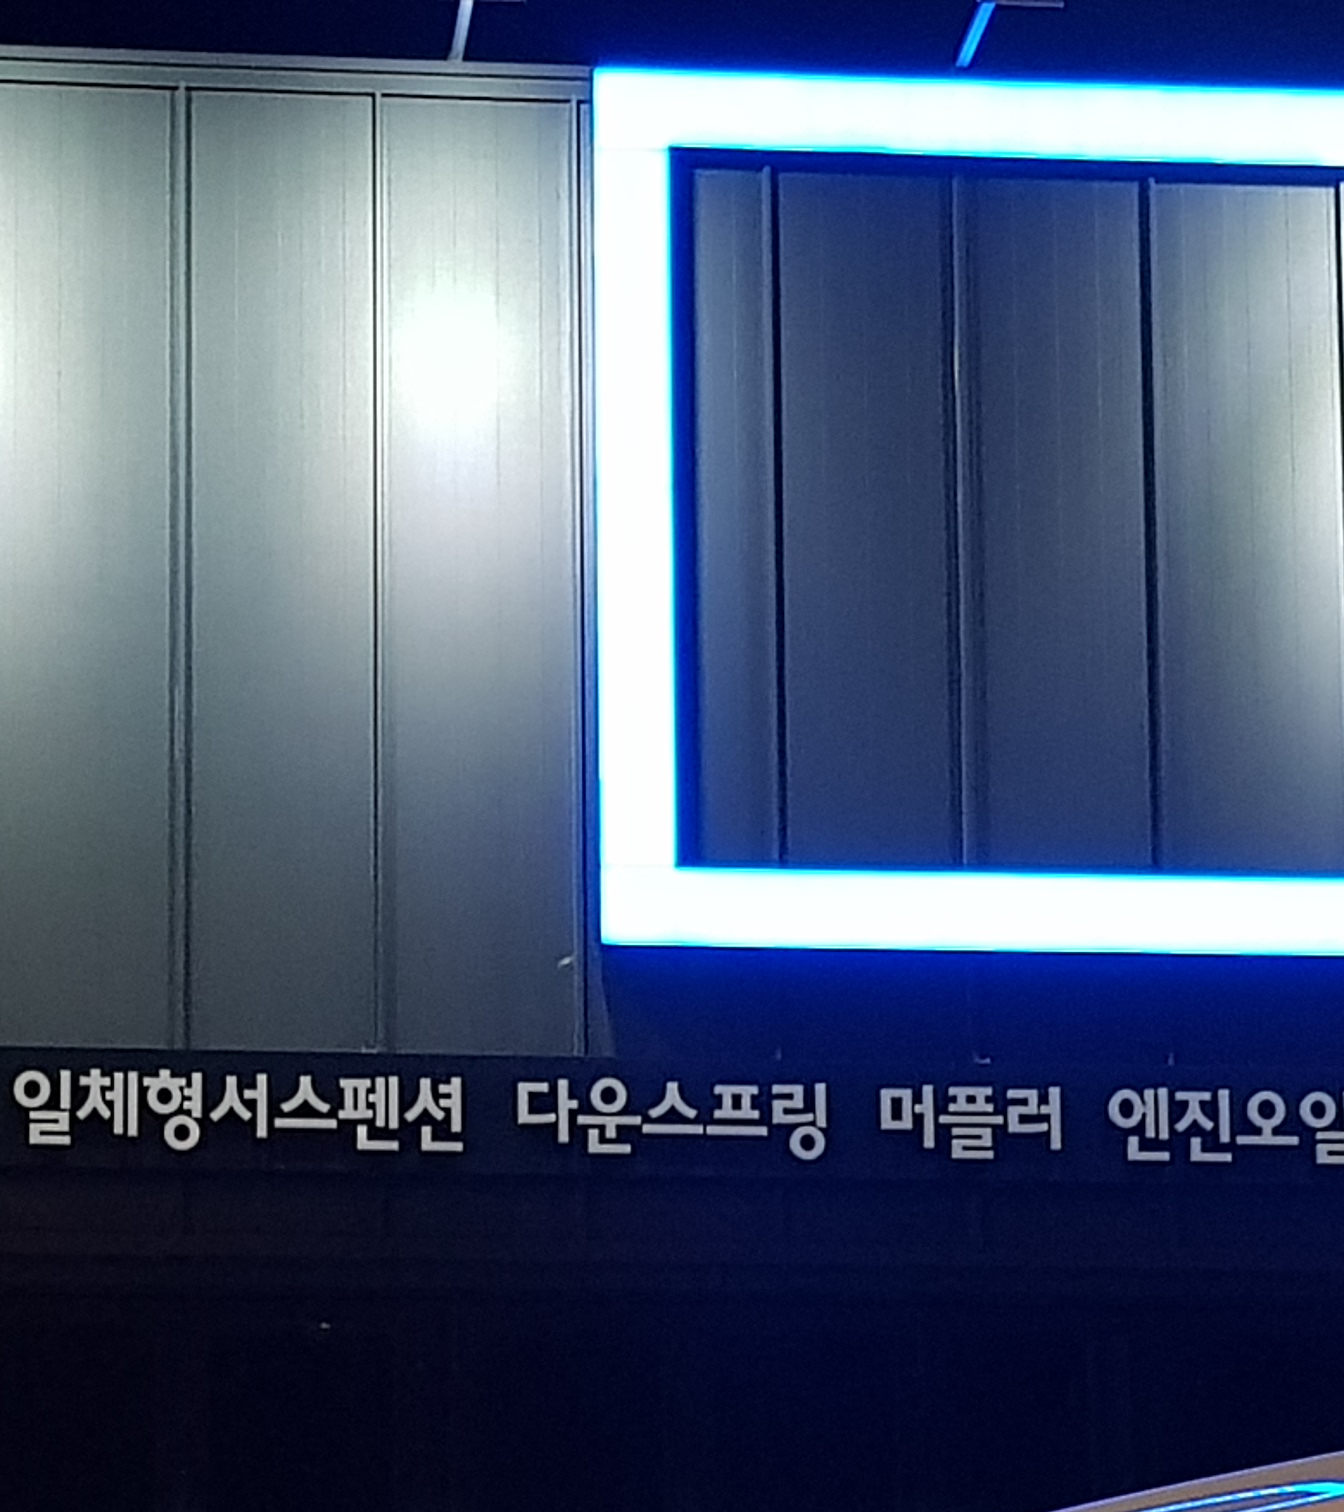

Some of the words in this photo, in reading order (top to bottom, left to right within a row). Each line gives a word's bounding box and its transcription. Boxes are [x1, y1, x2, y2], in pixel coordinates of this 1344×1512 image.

[13, 1068, 464, 1152] 일체형서스펜션
[517, 1077, 828, 1160] 다운스프링
[880, 1084, 1062, 1160] 머플러
